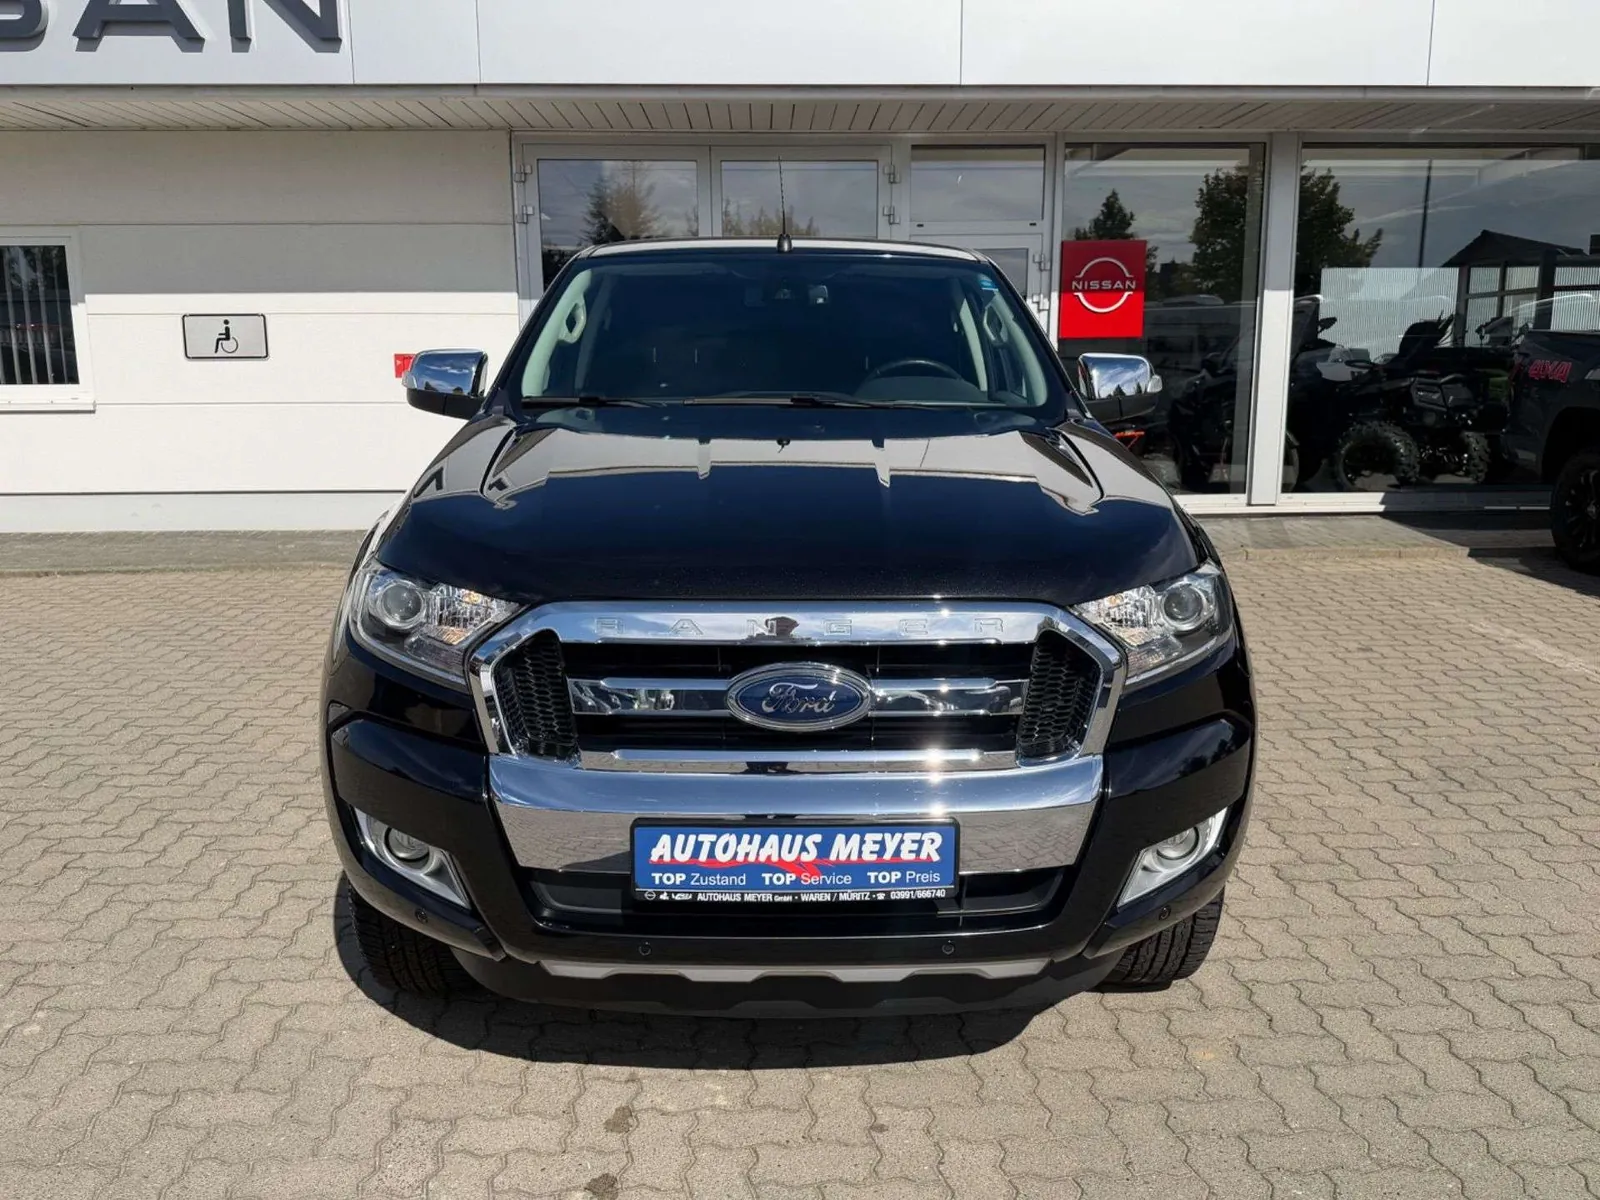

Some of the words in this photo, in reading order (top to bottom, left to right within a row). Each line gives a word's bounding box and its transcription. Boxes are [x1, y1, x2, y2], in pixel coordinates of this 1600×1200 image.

[0, 0, 342, 39] AN
[1071, 280, 1136, 290] NISSAN
[594, 616, 1004, 637] RANGER
[761, 682, 837, 714] Ford
[650, 833, 822, 863] AUTOHAUS
[829, 832, 943, 862] MEYER
[651, 872, 687, 885] TOP
[690, 873, 747, 886] Zustand
[761, 873, 797, 886] TOP
[800, 872, 853, 885] Service
[867, 871, 902, 884] TOP
[905, 870, 941, 883] Preis
[697, 892, 742, 902] AUTOHAUS
[744, 893, 773, 903] MEYER
[800, 893, 831, 902] WAREN
[839, 890, 871, 901] MÜRITZ
